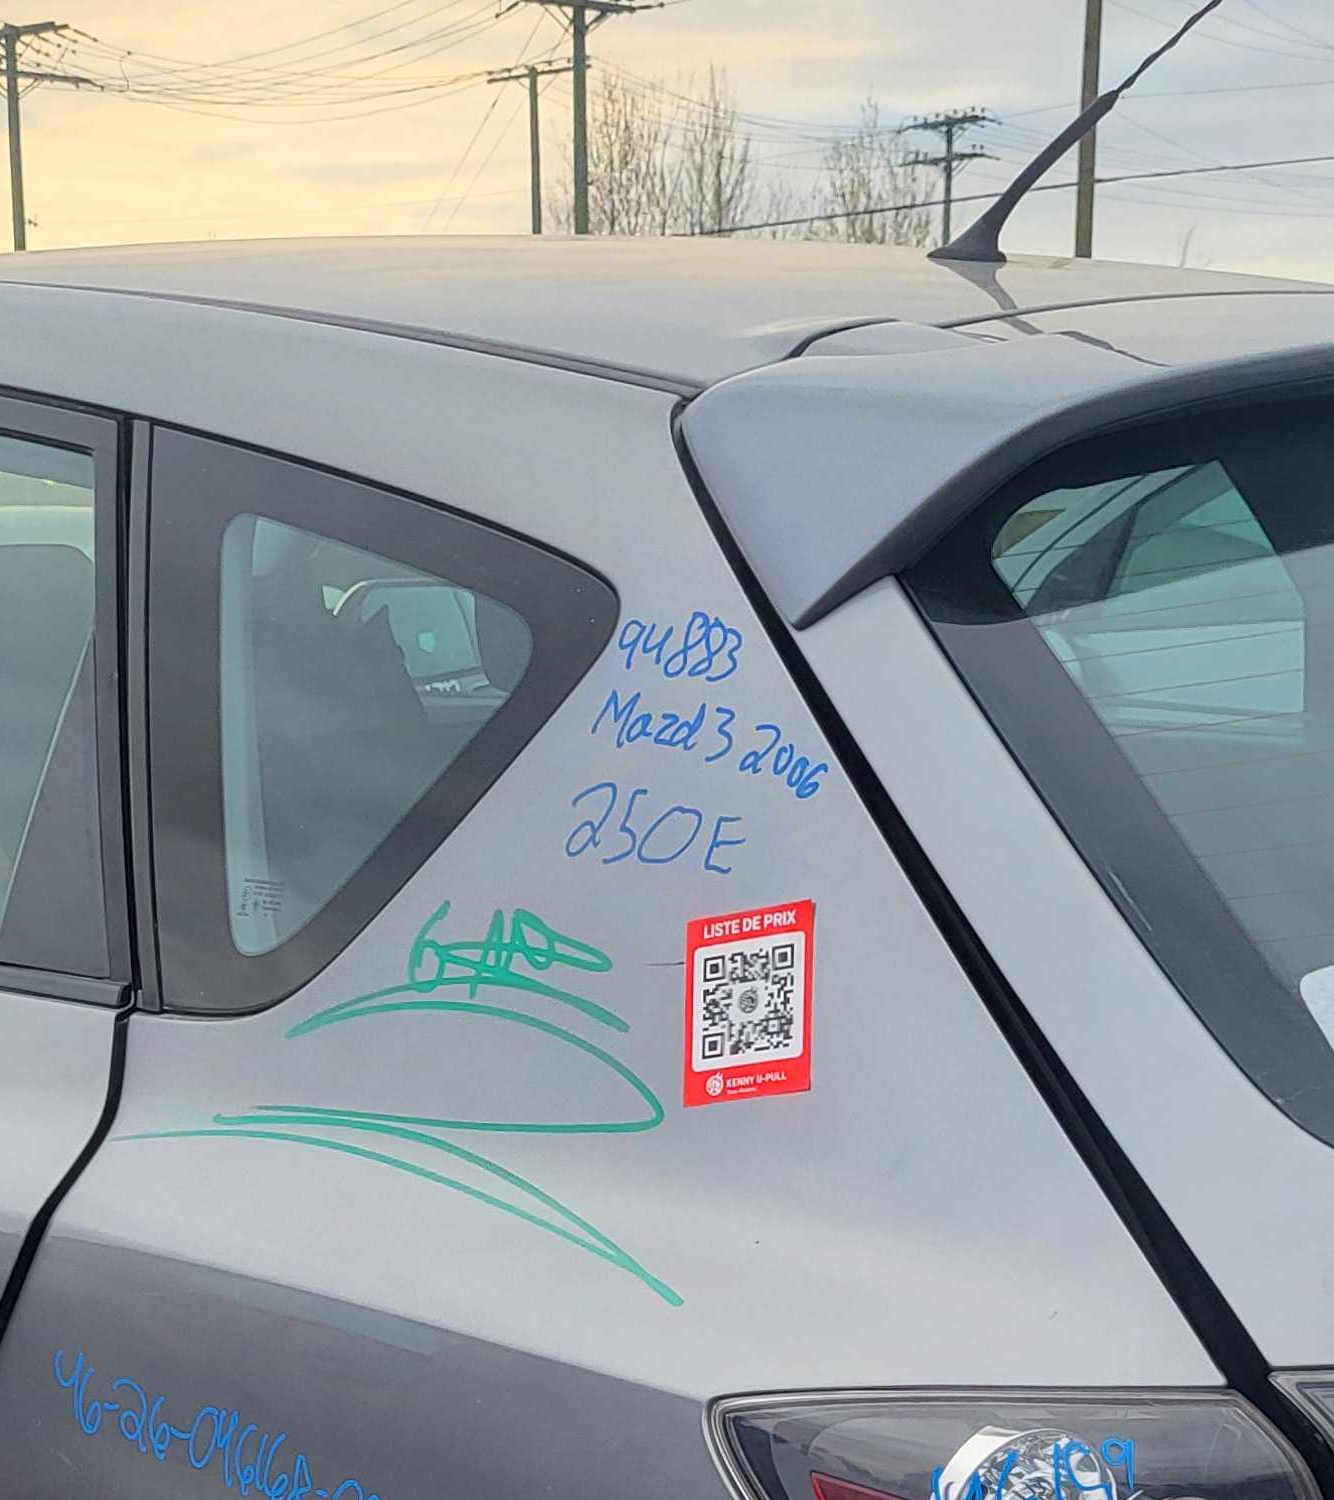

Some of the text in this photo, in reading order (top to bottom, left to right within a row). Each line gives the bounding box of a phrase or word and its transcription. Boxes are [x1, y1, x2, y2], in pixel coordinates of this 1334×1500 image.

[619, 610, 744, 682] 94883
[739, 723, 829, 799] 2006
[703, 909, 796, 939] LISTE DE PRIX
[756, 1071, 788, 1085] U-PULL
